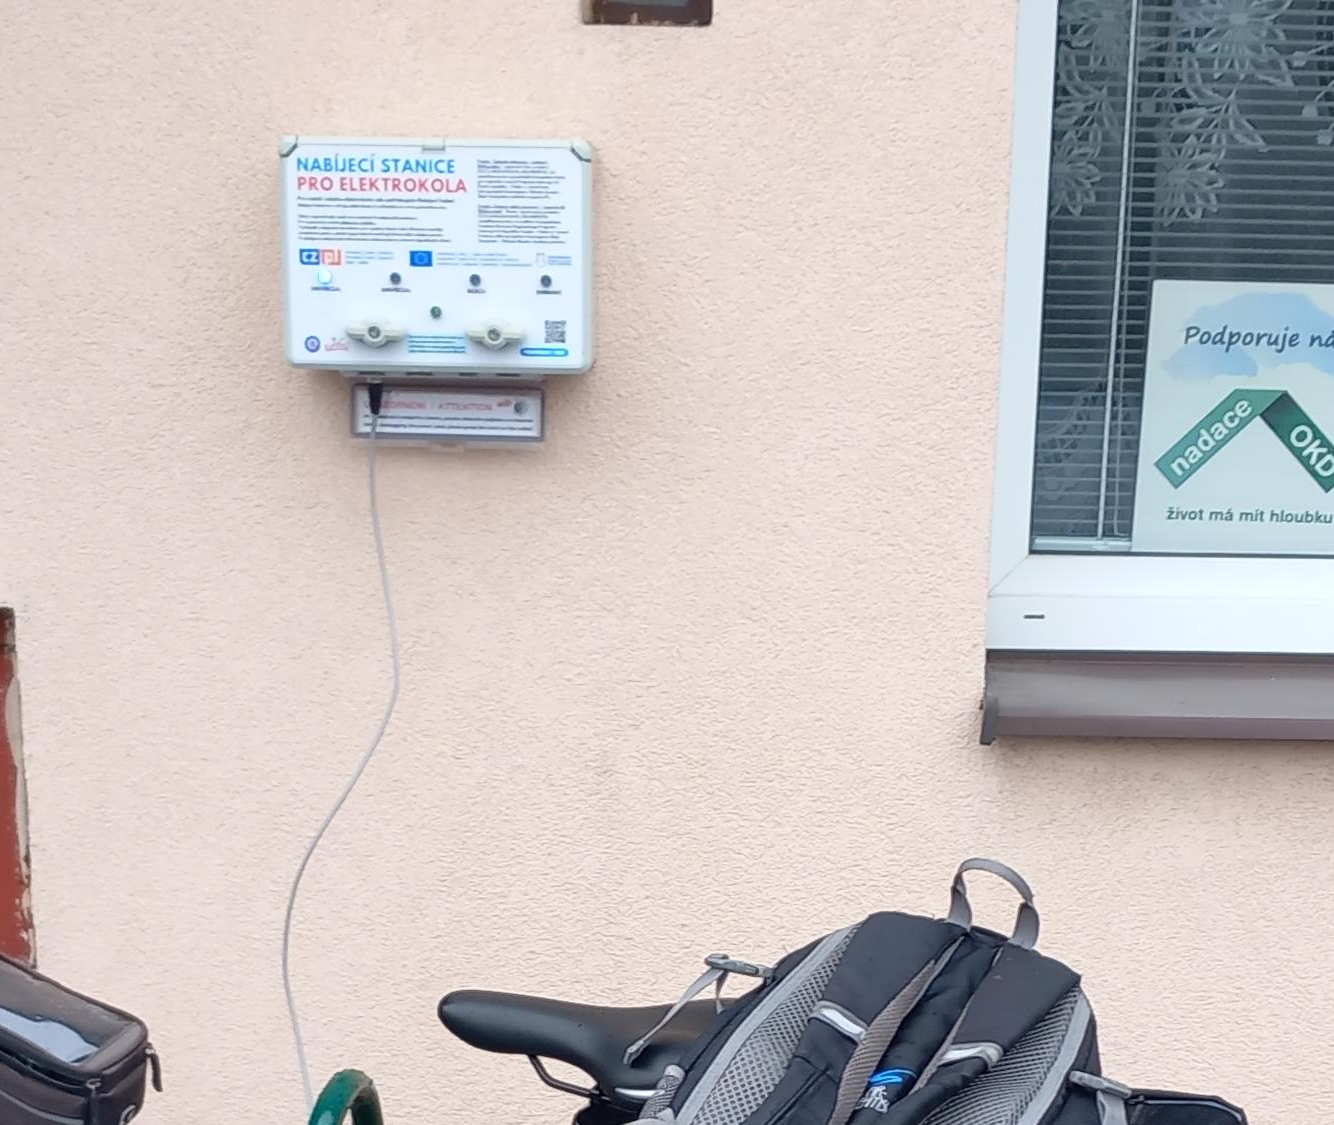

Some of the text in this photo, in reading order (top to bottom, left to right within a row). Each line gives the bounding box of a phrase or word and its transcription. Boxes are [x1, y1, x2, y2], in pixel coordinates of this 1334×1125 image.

[297, 154, 456, 174] NABÍJECÍ STANICE
[297, 176, 334, 192] PRO
[339, 177, 468, 194] ELEKTROKOLA
[1183, 324, 1300, 353] Podporuje
[1170, 399, 1253, 477] nadace
[1166, 506, 1204, 522] život
[1209, 508, 1233, 522] má
[1269, 508, 1334, 524] hloubku
